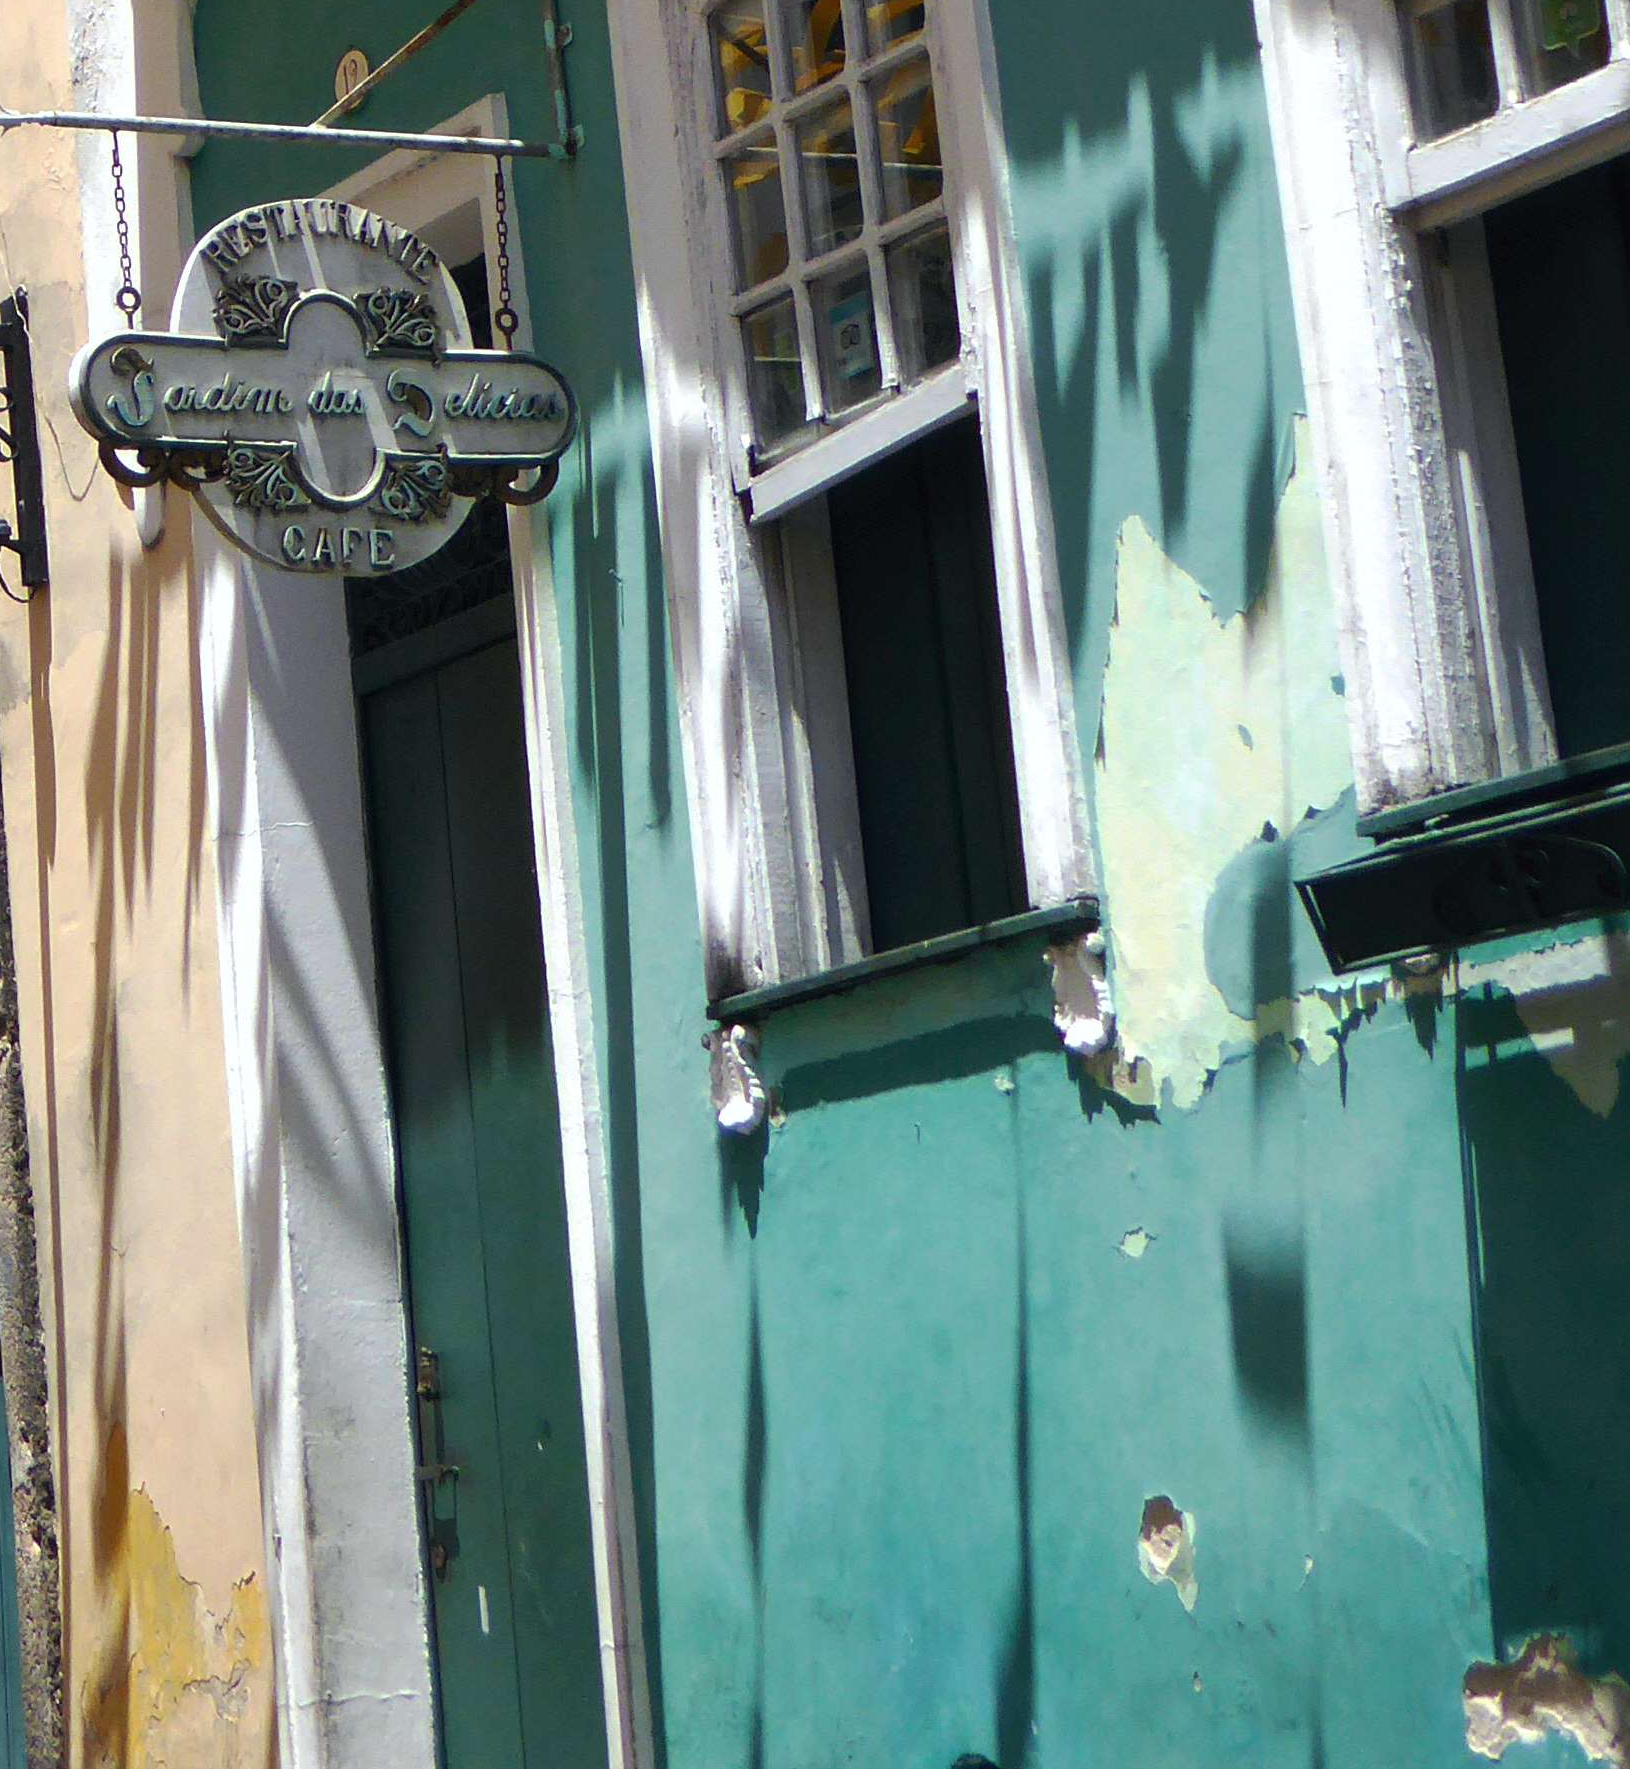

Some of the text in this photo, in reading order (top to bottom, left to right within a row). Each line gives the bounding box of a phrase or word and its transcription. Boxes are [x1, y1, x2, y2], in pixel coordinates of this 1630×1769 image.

[199, 198, 443, 286] RESTAURANTE
[105, 347, 294, 428] Jardim
[306, 369, 368, 418] das
